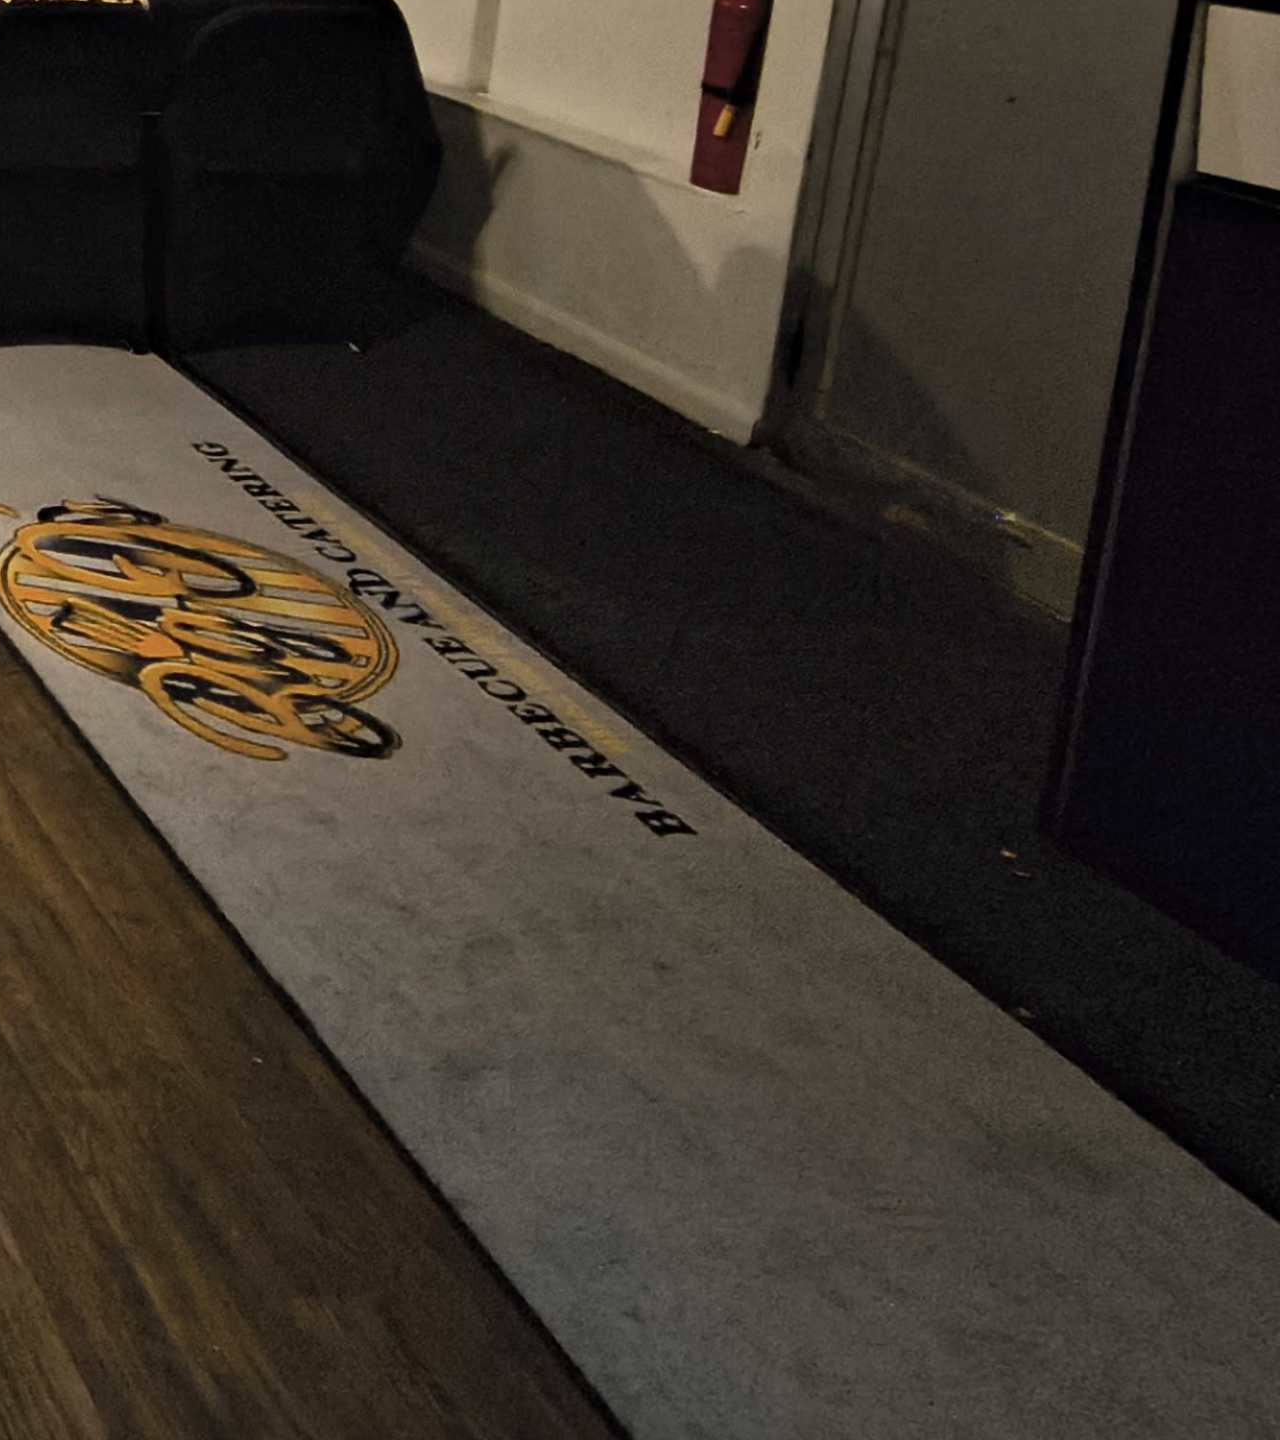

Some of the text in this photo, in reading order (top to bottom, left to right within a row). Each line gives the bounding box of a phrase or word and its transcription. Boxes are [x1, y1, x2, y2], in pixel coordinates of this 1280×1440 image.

[191, 441, 357, 563] CATERING
[344, 566, 447, 632] AND
[422, 635, 700, 838] BARBECUE
